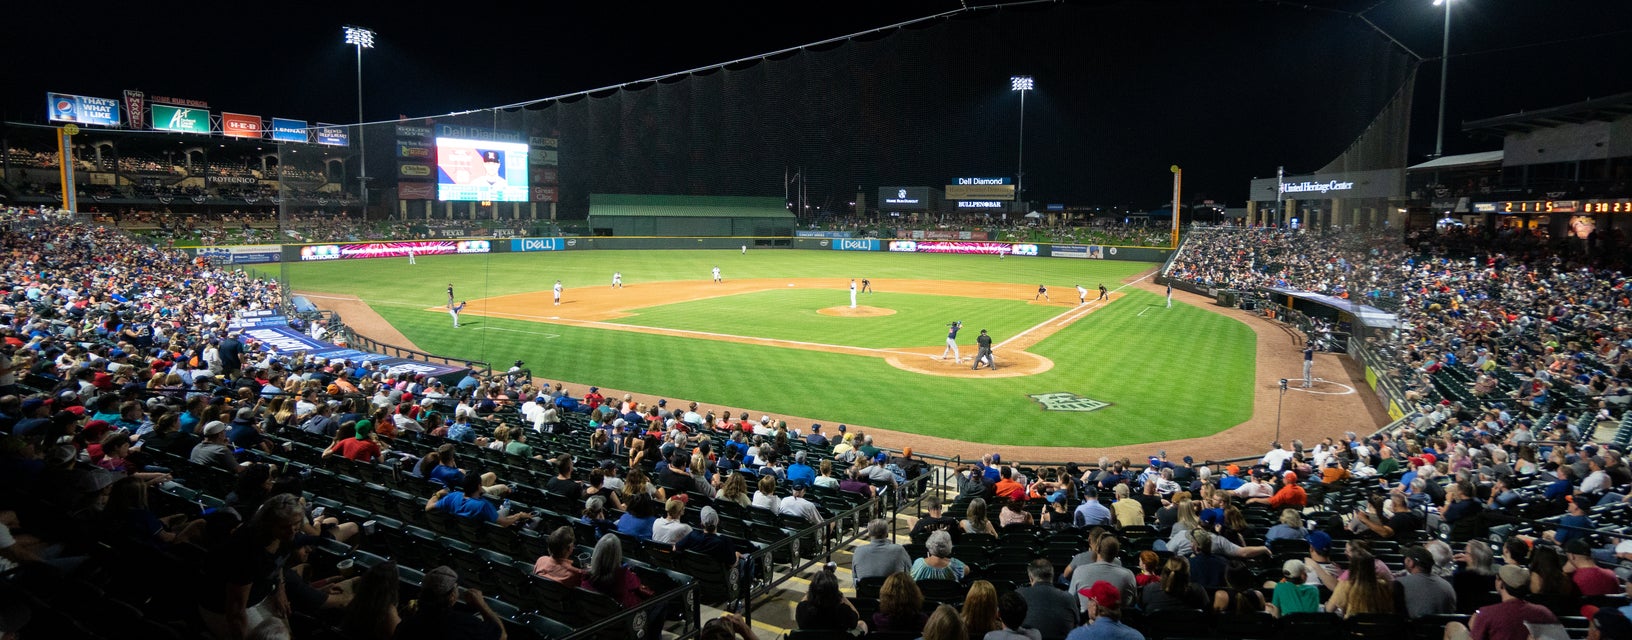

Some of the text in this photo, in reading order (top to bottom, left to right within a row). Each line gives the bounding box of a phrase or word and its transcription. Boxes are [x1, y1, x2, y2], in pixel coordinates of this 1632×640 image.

[82, 96, 116, 106] THAT'S
[83, 104, 112, 112] WHAT
[130, 98, 140, 128] MAXWELL
[230, 122, 256, 130] H-E-B
[443, 126, 520, 141] Dell Diamond
[1284, 180, 1354, 193] United Heritage Center
[1505, 202, 1512, 212] 2
[1614, 202, 1620, 212] 2
[1624, 202, 1631, 212] 3
